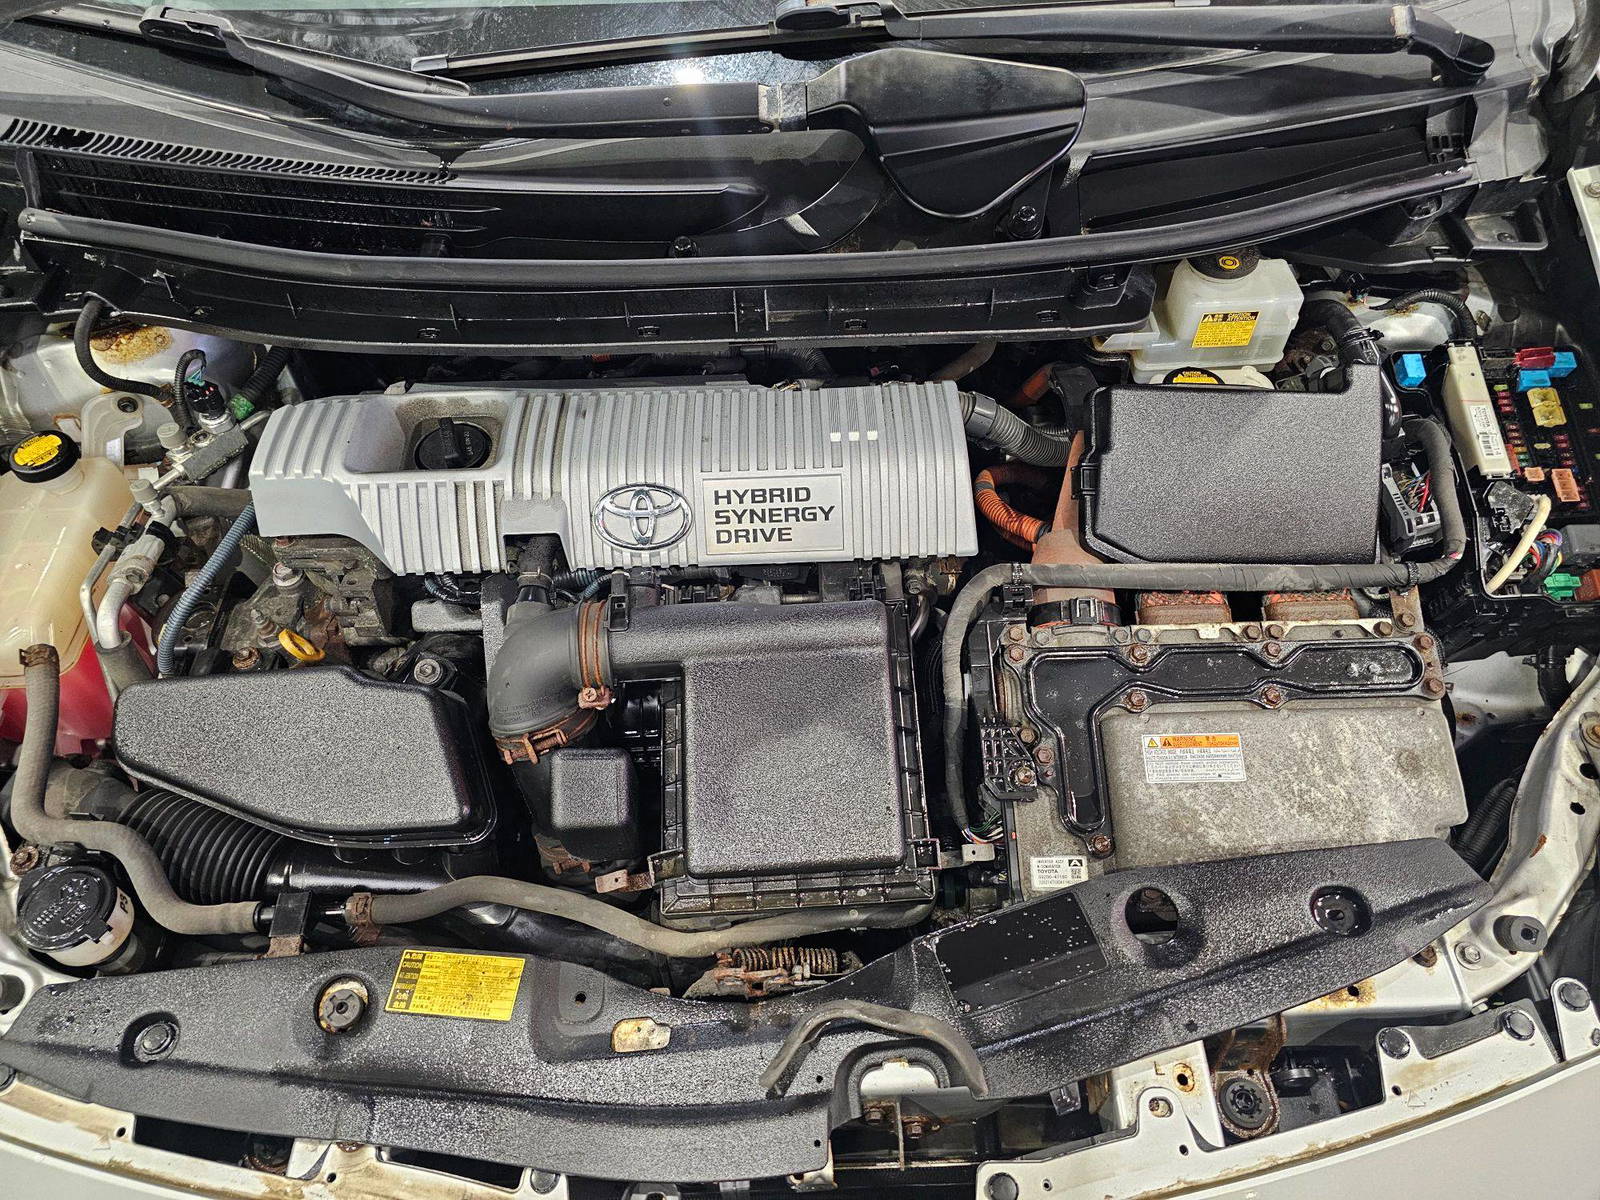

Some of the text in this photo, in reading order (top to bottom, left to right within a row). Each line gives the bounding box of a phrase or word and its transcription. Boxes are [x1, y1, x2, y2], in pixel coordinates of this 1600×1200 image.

[713, 486, 812, 506] HYBRID
[715, 505, 836, 526] SYNERGY
[715, 527, 793, 545] DRIVE
[402, 961, 423, 969] CAUTION
